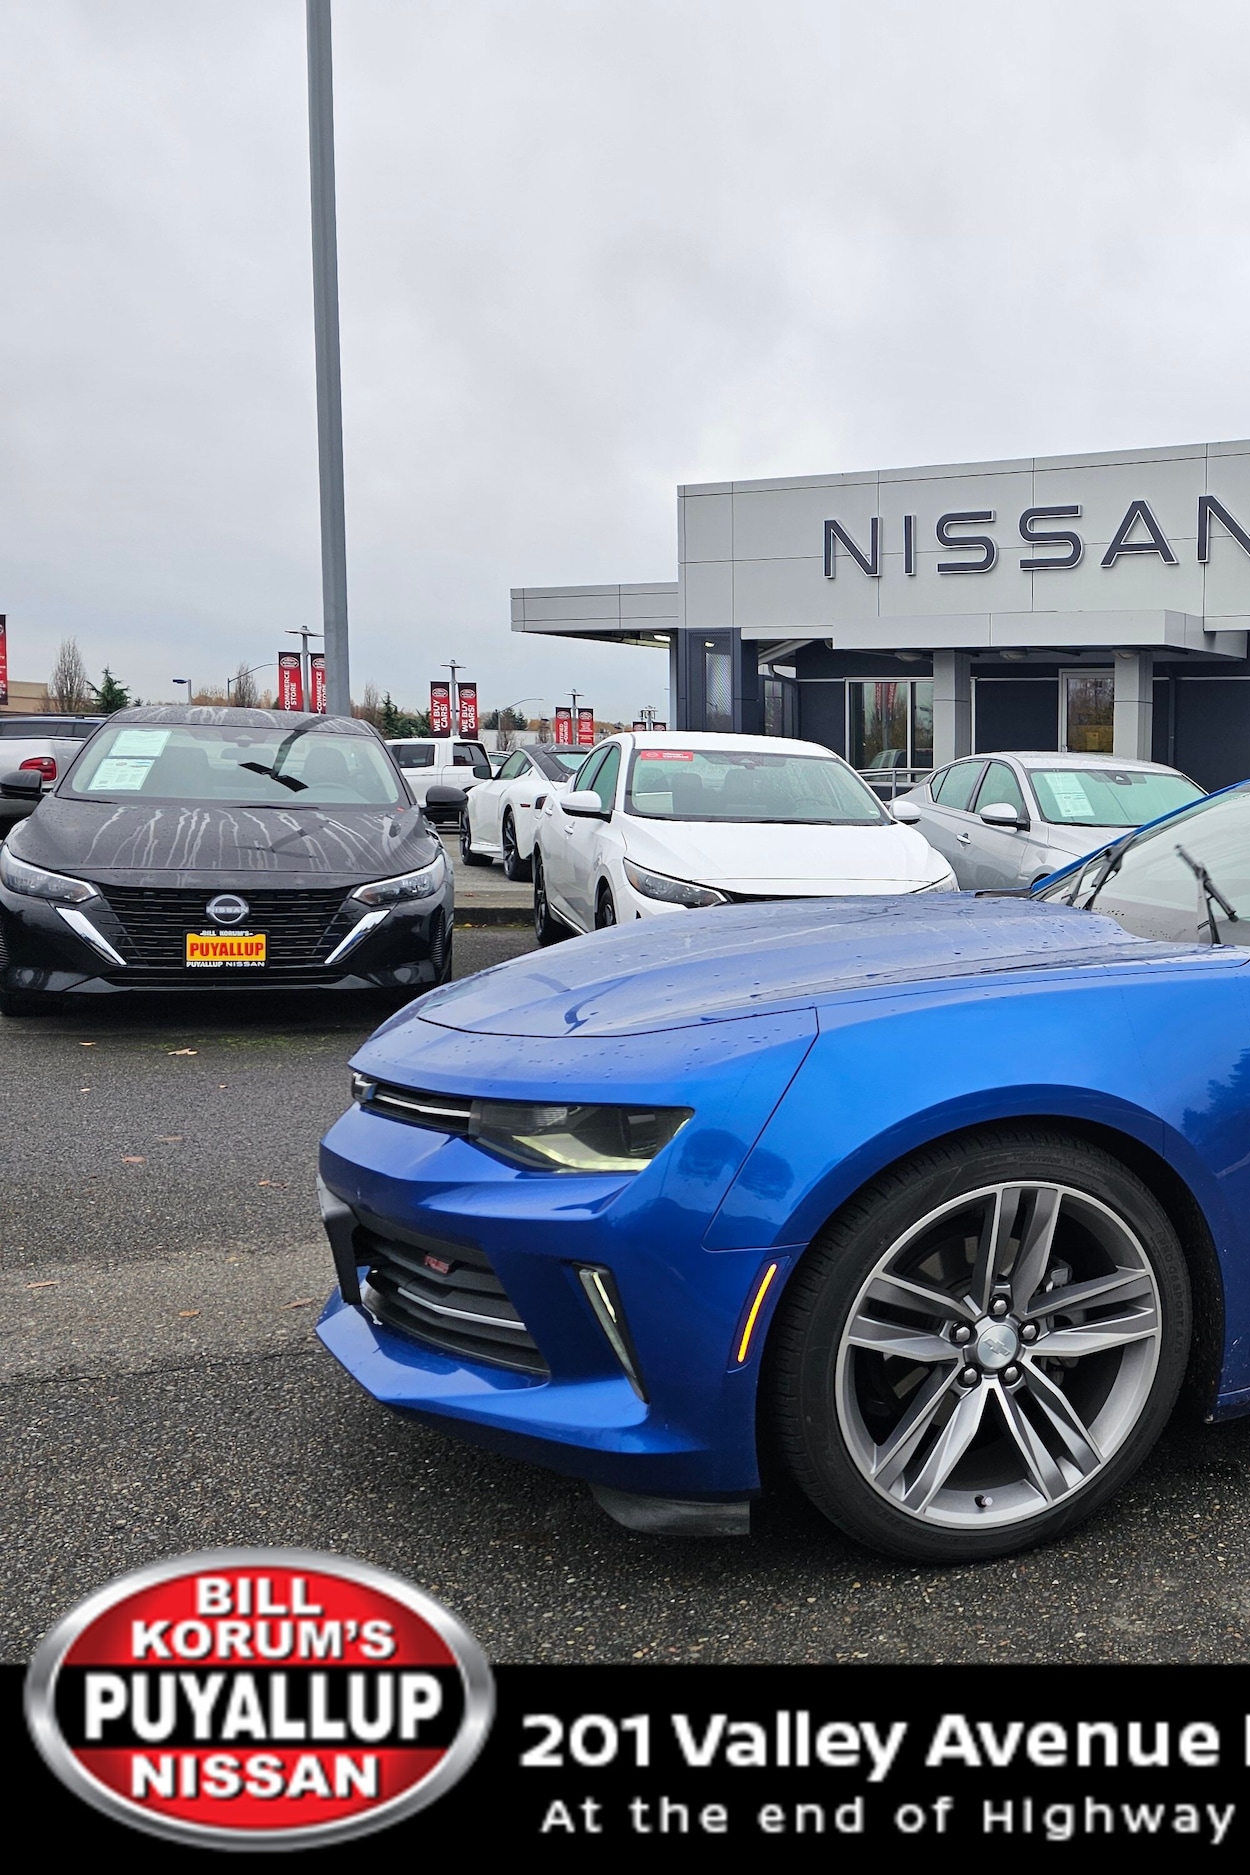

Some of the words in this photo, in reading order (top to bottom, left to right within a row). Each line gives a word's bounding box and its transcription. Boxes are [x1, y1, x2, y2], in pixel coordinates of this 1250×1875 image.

[440, 704, 448, 728] CARS!
[468, 705, 476, 729] CARS!
[433, 718, 441, 732] WE
[461, 719, 469, 733] WE
[206, 905, 249, 914] NISSAN
[189, 942, 264, 957] PUYALLUP
